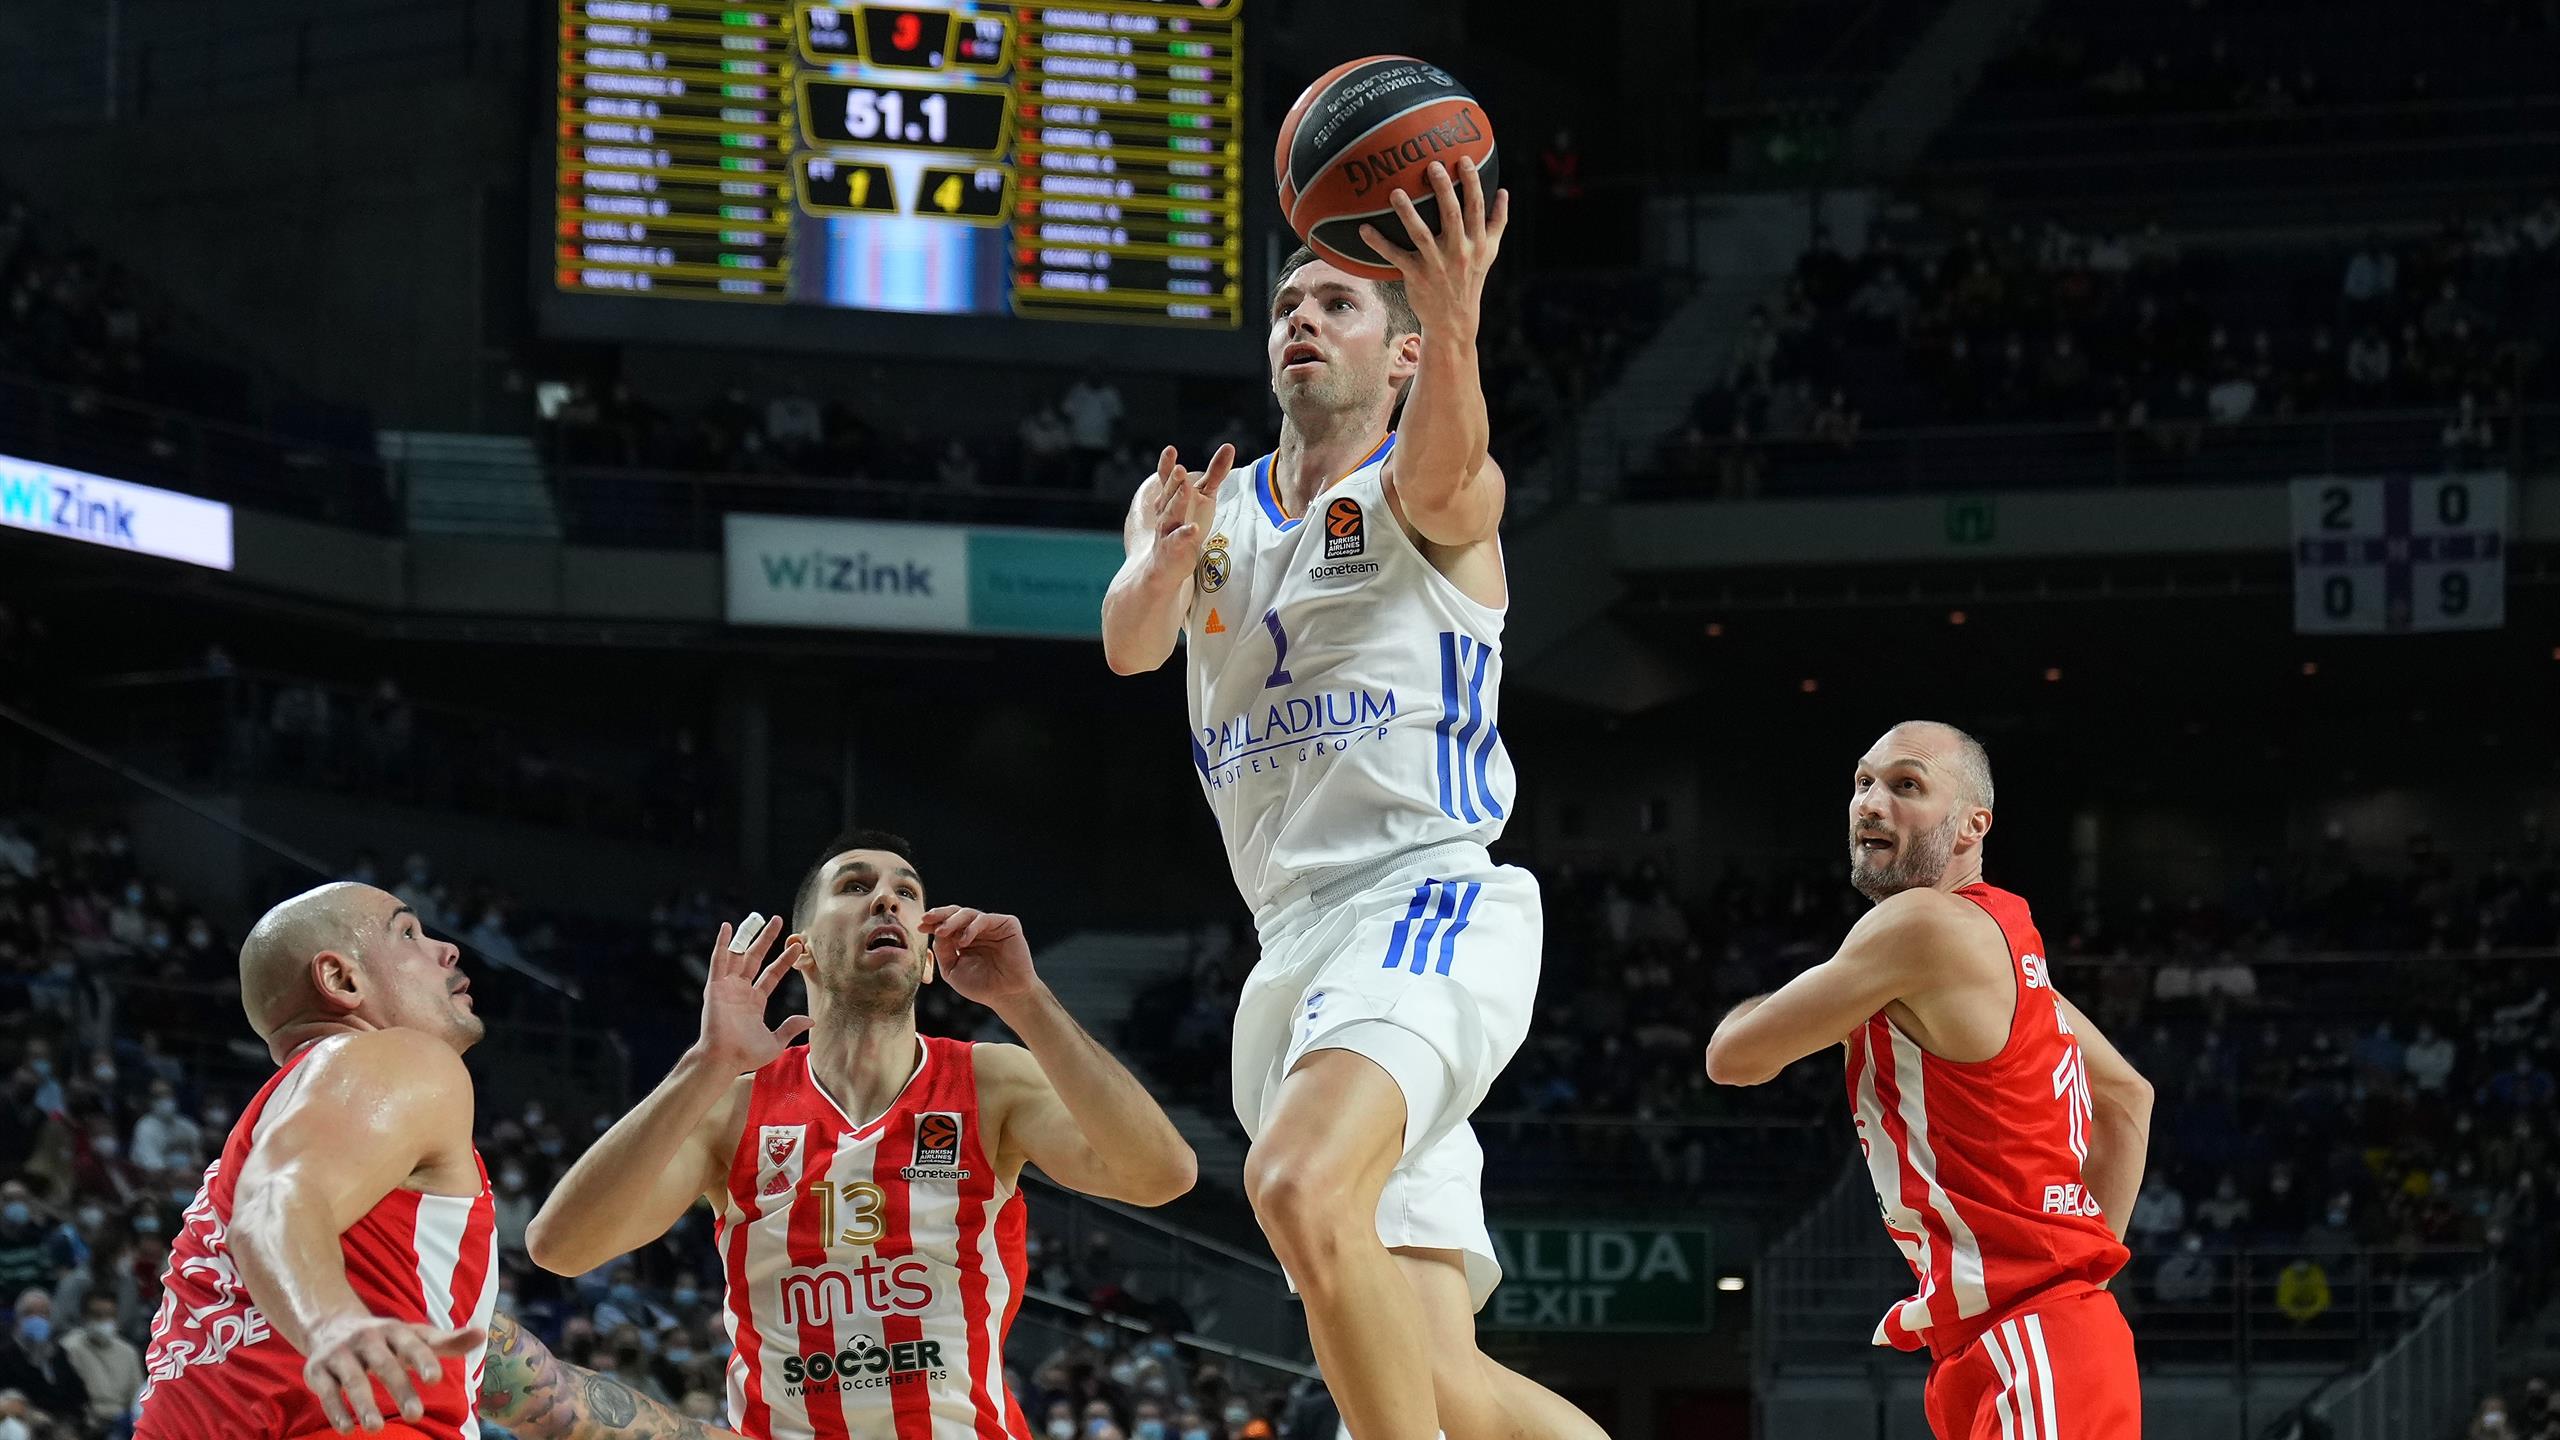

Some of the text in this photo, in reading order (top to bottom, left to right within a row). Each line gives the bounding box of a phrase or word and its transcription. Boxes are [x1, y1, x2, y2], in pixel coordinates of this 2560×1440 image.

[892, 13, 922, 51] 3
[845, 88, 948, 143] 51.1
[1313, 74, 1427, 149] TURKISH AIRLINES
[1343, 107, 1482, 197] SPALDING
[848, 168, 872, 208] 1
[933, 174, 964, 212] 4
[0, 472, 135, 539] WiZink
[2321, 484, 2469, 529] 2 0
[1328, 542, 1360, 552] AIRLINES
[1329, 535, 1360, 546] TURKISH
[761, 551, 934, 597] WiZink
[2323, 576, 2354, 618] 0
[1261, 607, 1293, 689] 1
[1203, 688, 1397, 758] PALLADIUM
[1211, 726, 1388, 791] HOTEL GROP
[810, 1180, 887, 1249] 13
[780, 1254, 934, 1325] mts
[1495, 1285, 1617, 1324] EXIT
[783, 1339, 945, 1384] SOCCER
